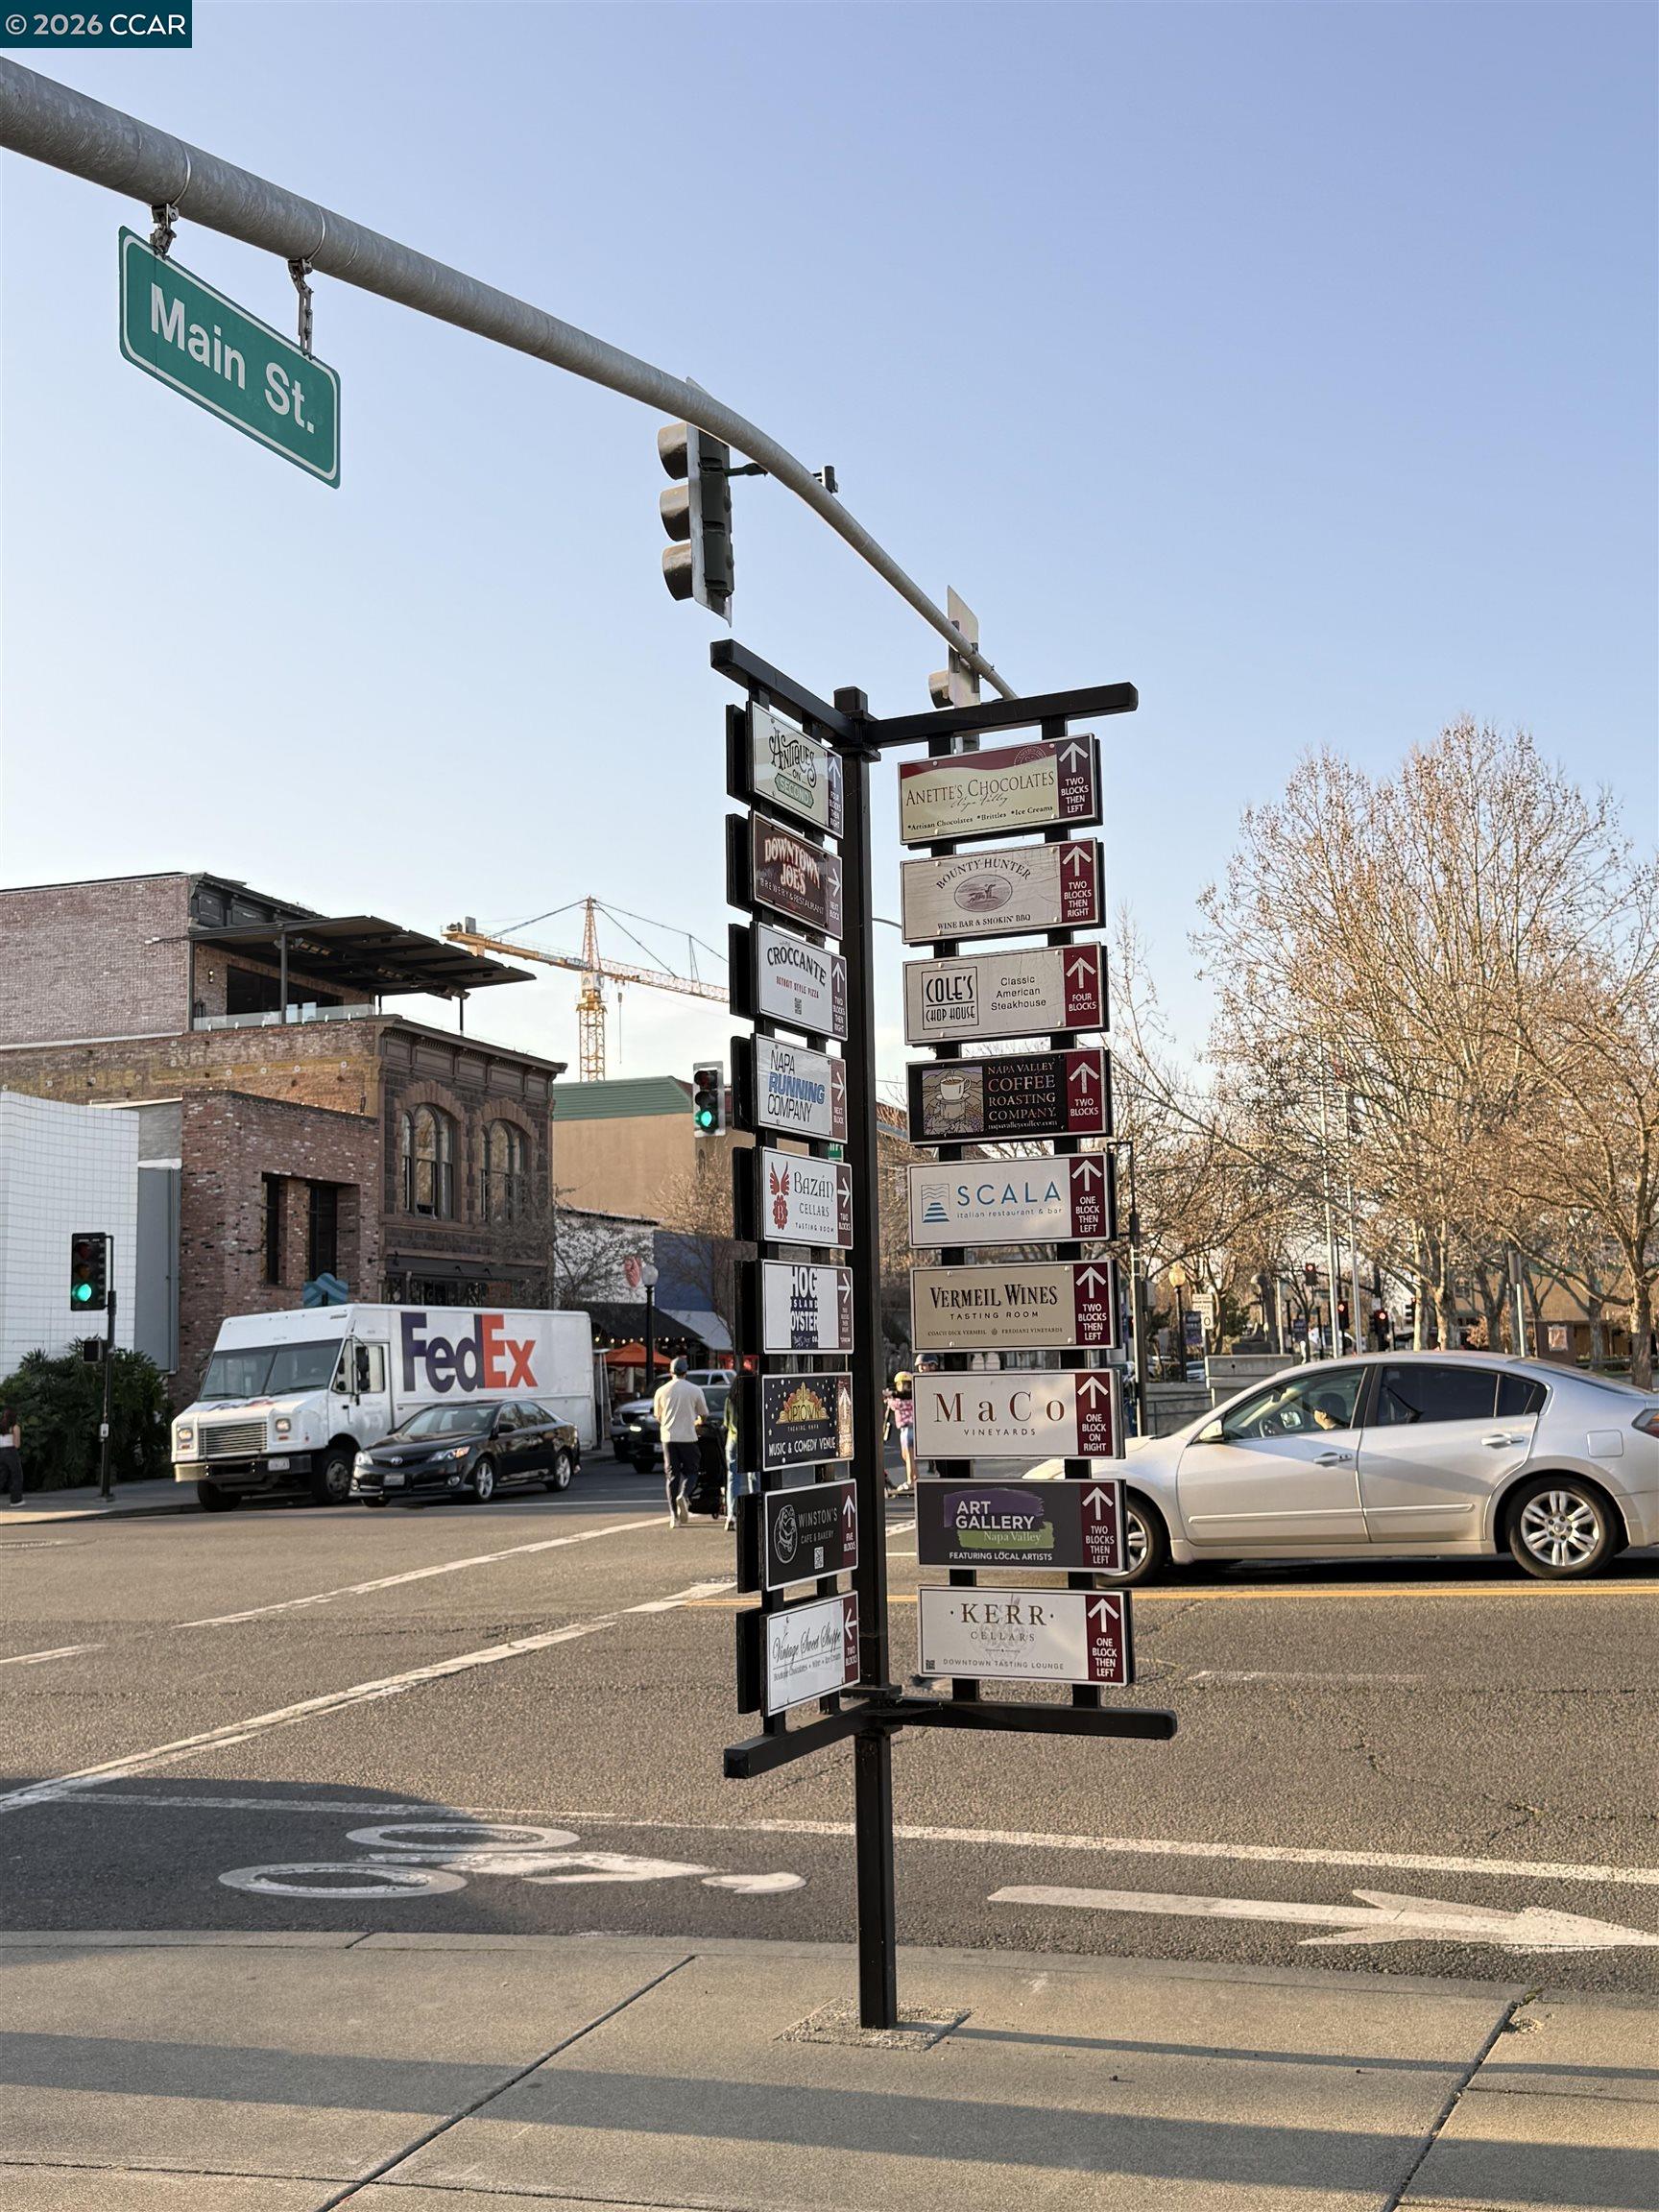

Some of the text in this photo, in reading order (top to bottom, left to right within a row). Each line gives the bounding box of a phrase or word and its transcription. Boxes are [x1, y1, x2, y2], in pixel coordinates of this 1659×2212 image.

[151, 282, 315, 432] Main St.
[769, 727, 816, 788] ANTIQUES
[1065, 777, 1084, 786] TWO
[780, 778, 810, 805] SECOND
[905, 771, 1054, 806] ANETTE'S CHOCOLATES
[1061, 784, 1090, 796] BLOCKS
[1066, 795, 1086, 805] THEN
[1068, 804, 1084, 813] LEFT
[937, 816, 973, 827] Chocolates
[764, 837, 821, 889] DOWNTOWN
[936, 858, 1031, 890] BOUNTY HUNTER
[781, 864, 806, 896] JOE'S
[1068, 881, 1088, 890] TWO
[759, 878, 788, 898] BREWERY
[793, 894, 824, 915] RESTAURANT
[1064, 889, 1092, 901] BLOCKS
[1069, 899, 1088, 909] THEN
[1068, 907, 1090, 918] RIGHT
[937, 921, 958, 930] WINE
[958, 920, 974, 929] BAR
[1016, 914, 1031, 923] BBQ
[767, 947, 827, 987] CROCCANTE
[1000, 975, 1036, 986] Classic
[926, 975, 974, 1003] COLE'S
[996, 987, 1041, 998] American
[1072, 993, 1093, 1002] FOUR
[991, 998, 1046, 1011] Steakhouse
[1069, 1001, 1097, 1012] BLOCKS
[926, 1005, 975, 1022] CHOP HOUSE
[771, 1049, 796, 1074] NAPA
[988, 1062, 1055, 1075] NAPA VALLEY
[769, 1071, 825, 1105] RUNNING
[988, 1074, 1056, 1093] COFFEE
[989, 1093, 1056, 1107] ROASTING
[1074, 1097, 1094, 1107] TWO
[768, 1094, 813, 1123] COMPANY
[989, 1107, 1056, 1121] COMPANY
[1070, 1107, 1099, 1117] BLOCKS
[957, 1181, 1062, 1207] SCALA
[1080, 1196, 1096, 1205] ONE
[799, 1202, 830, 1217] CELLARS
[957, 1210, 985, 1219] italian
[989, 1208, 1034, 1217] restaurant
[1075, 1205, 1100, 1214] BLOCK
[1078, 1214, 1098, 1224] THEN
[1080, 1224, 1097, 1234] LEFT
[929, 1284, 1058, 1310] VERMEIL WINES
[1082, 1304, 1102, 1312] TWO
[790, 1310, 818, 1332] OYSTER
[950, 1312, 999, 1321] TASTING
[1078, 1312, 1107, 1322] BLOCKS
[1083, 1323, 1103, 1332] THEN
[1084, 1332, 1102, 1341] LEFT
[400, 1311, 539, 1393] FedEx
[787, 1405, 820, 1422] UPTOWN
[1086, 1413, 1103, 1423] ONE
[964, 1428, 1037, 1436] VINEYARDS
[1082, 1423, 1107, 1432] BLOCK
[1089, 1432, 1101, 1442] ON
[768, 1436, 836, 1456] MUSIC & COMEDY VENUE
[1083, 1442, 1107, 1452] RIGHT
[956, 1501, 992, 1515] ART
[798, 1507, 838, 1528] WINSTON'S
[955, 1516, 1035, 1529] GALLERY
[817, 1530, 834, 1542] BAKERY
[1091, 1526, 1108, 1535] TWO
[983, 1530, 1042, 1545] Napa Valley
[1085, 1535, 1115, 1545] BLOCKS
[1090, 1545, 1111, 1554] THEN
[950, 1551, 1053, 1561] FEATURING LOCAL ARTISTS
[1093, 1554, 1110, 1564] LEFT
[961, 1602, 1047, 1626] KERR
[971, 1631, 1036, 1642] CELLARS
[1096, 1638, 1113, 1647] ONE
[1092, 1647, 1118, 1657] BLOCK
[1094, 1658, 1116, 1668] THEN
[1096, 1668, 1114, 1677] LEFT
